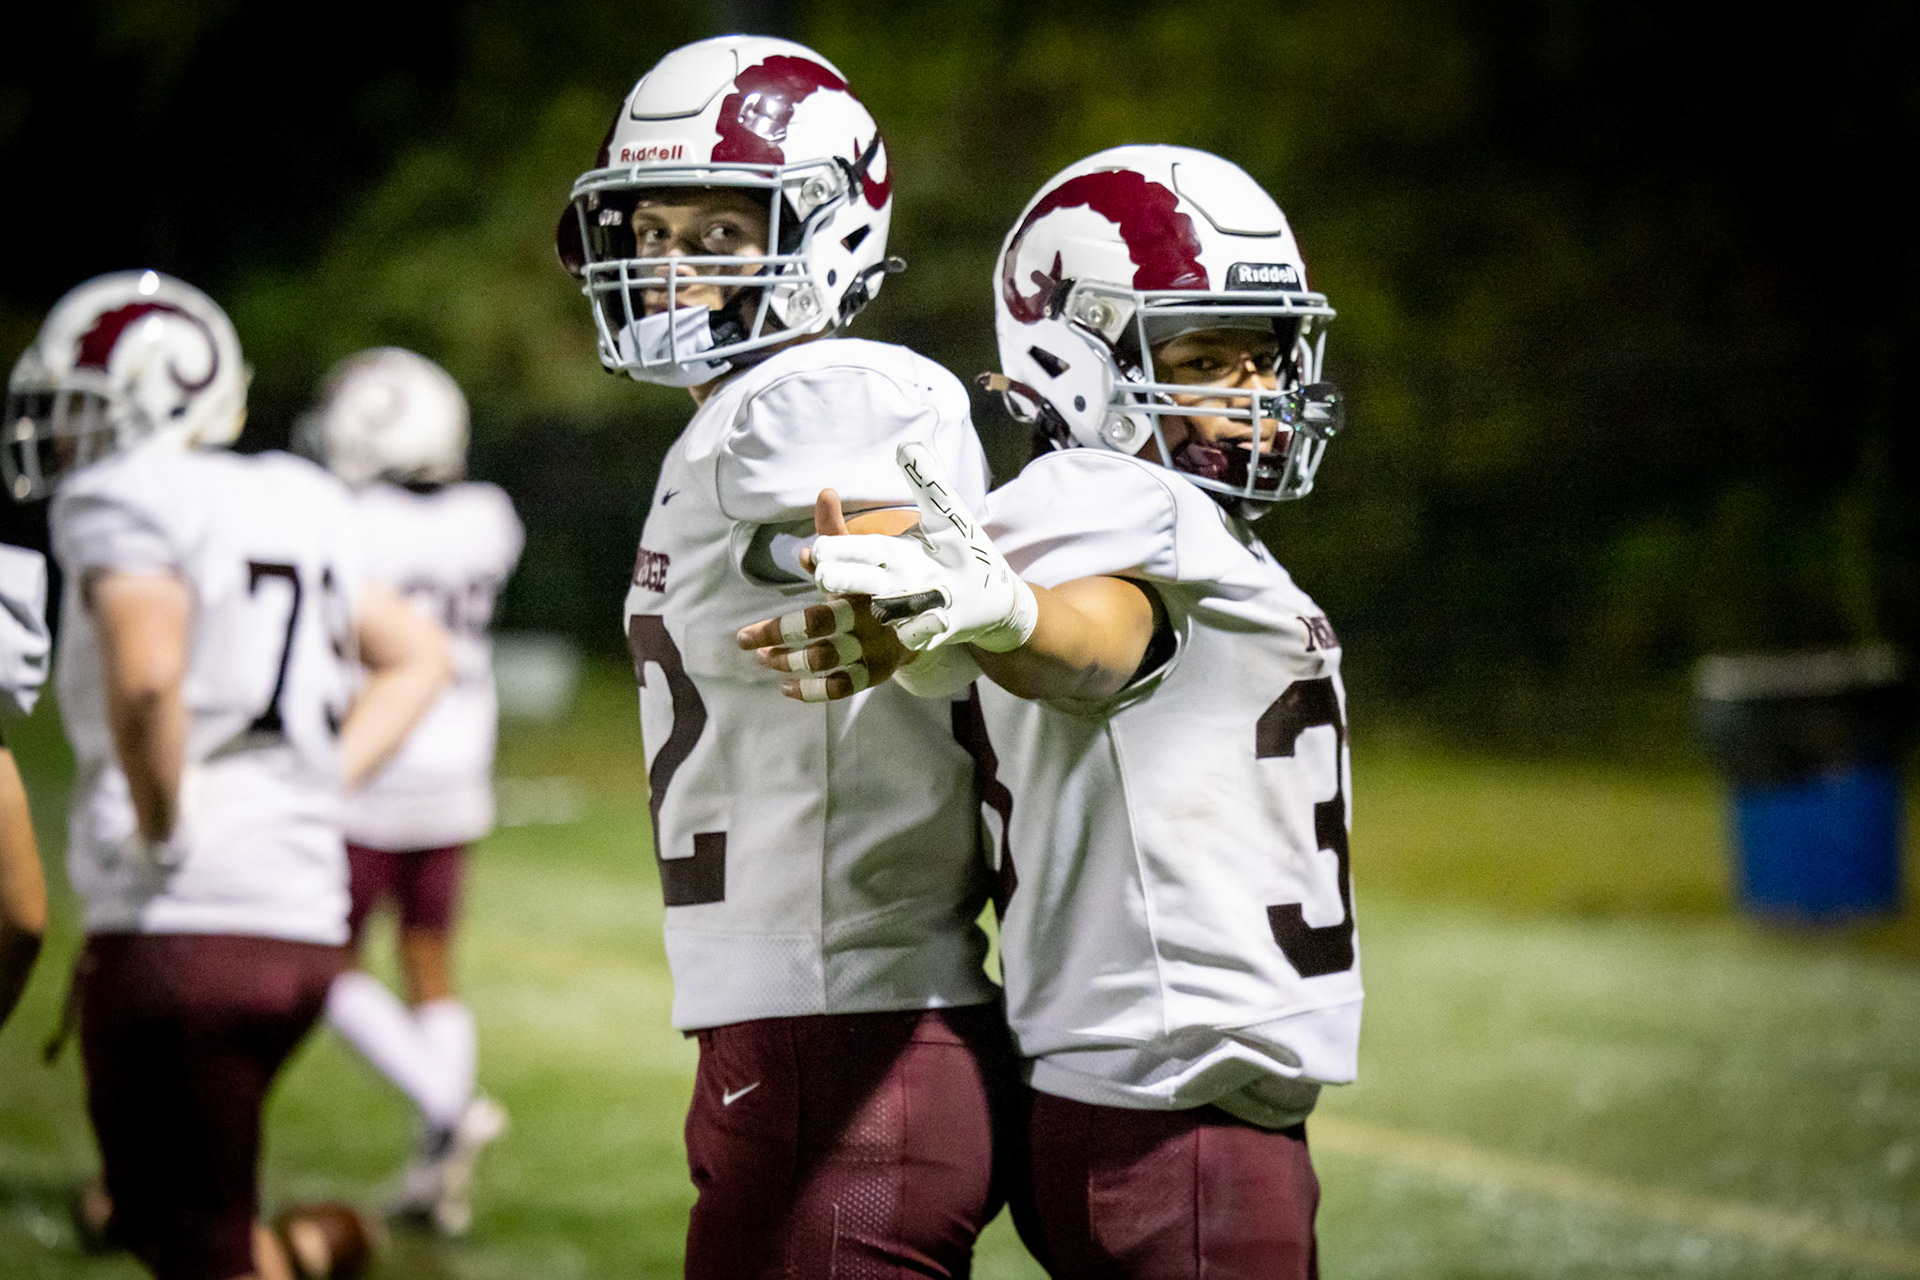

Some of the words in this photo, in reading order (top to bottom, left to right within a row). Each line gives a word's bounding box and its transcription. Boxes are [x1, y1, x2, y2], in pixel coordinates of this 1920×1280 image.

[621, 145, 683, 162] Riddell
[1238, 265, 1298, 283] Riddell
[628, 614, 727, 907] 2
